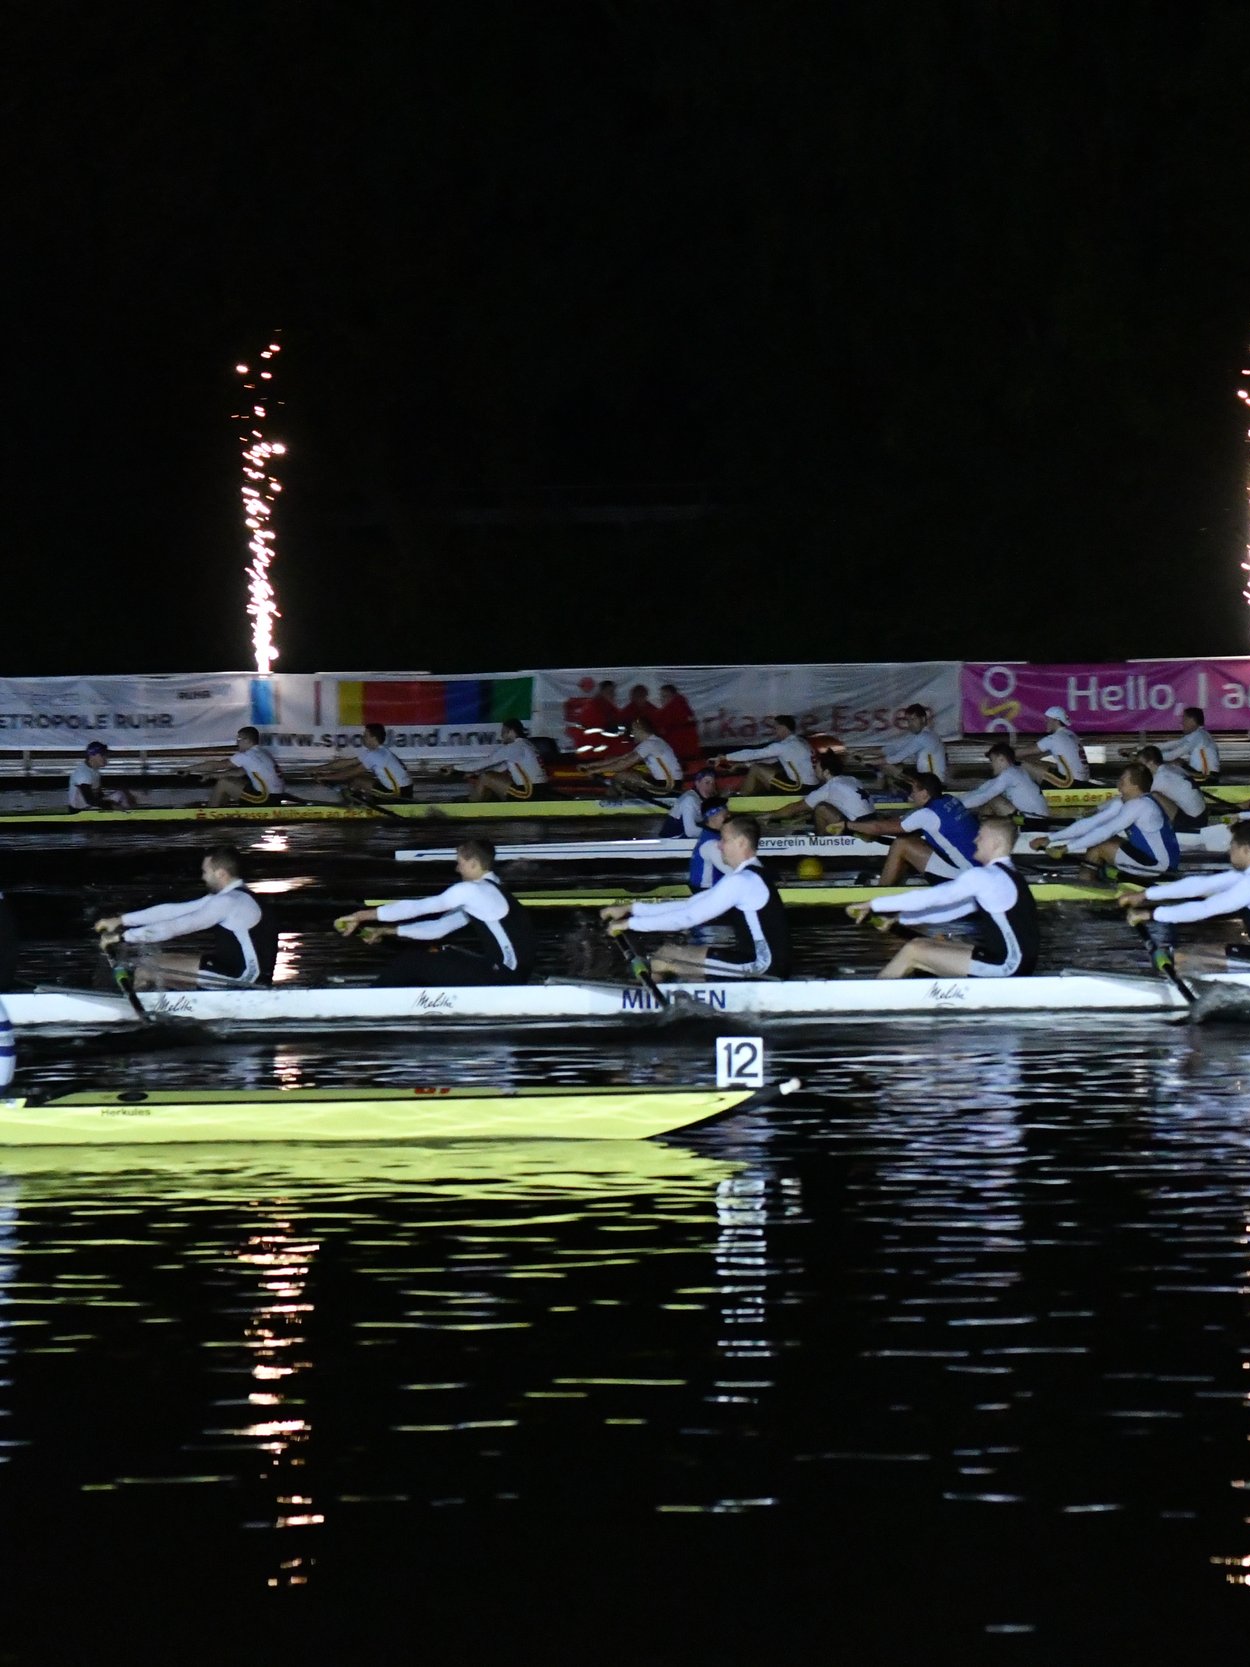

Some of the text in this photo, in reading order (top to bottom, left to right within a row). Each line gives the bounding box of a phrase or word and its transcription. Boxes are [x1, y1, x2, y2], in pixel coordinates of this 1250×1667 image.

[1067, 675, 1184, 716] Hello,
[114, 713, 173, 729] RUHR
[831, 704, 935, 732] Esse
[758, 837, 806, 847] erverein
[723, 1041, 759, 1078] 12
